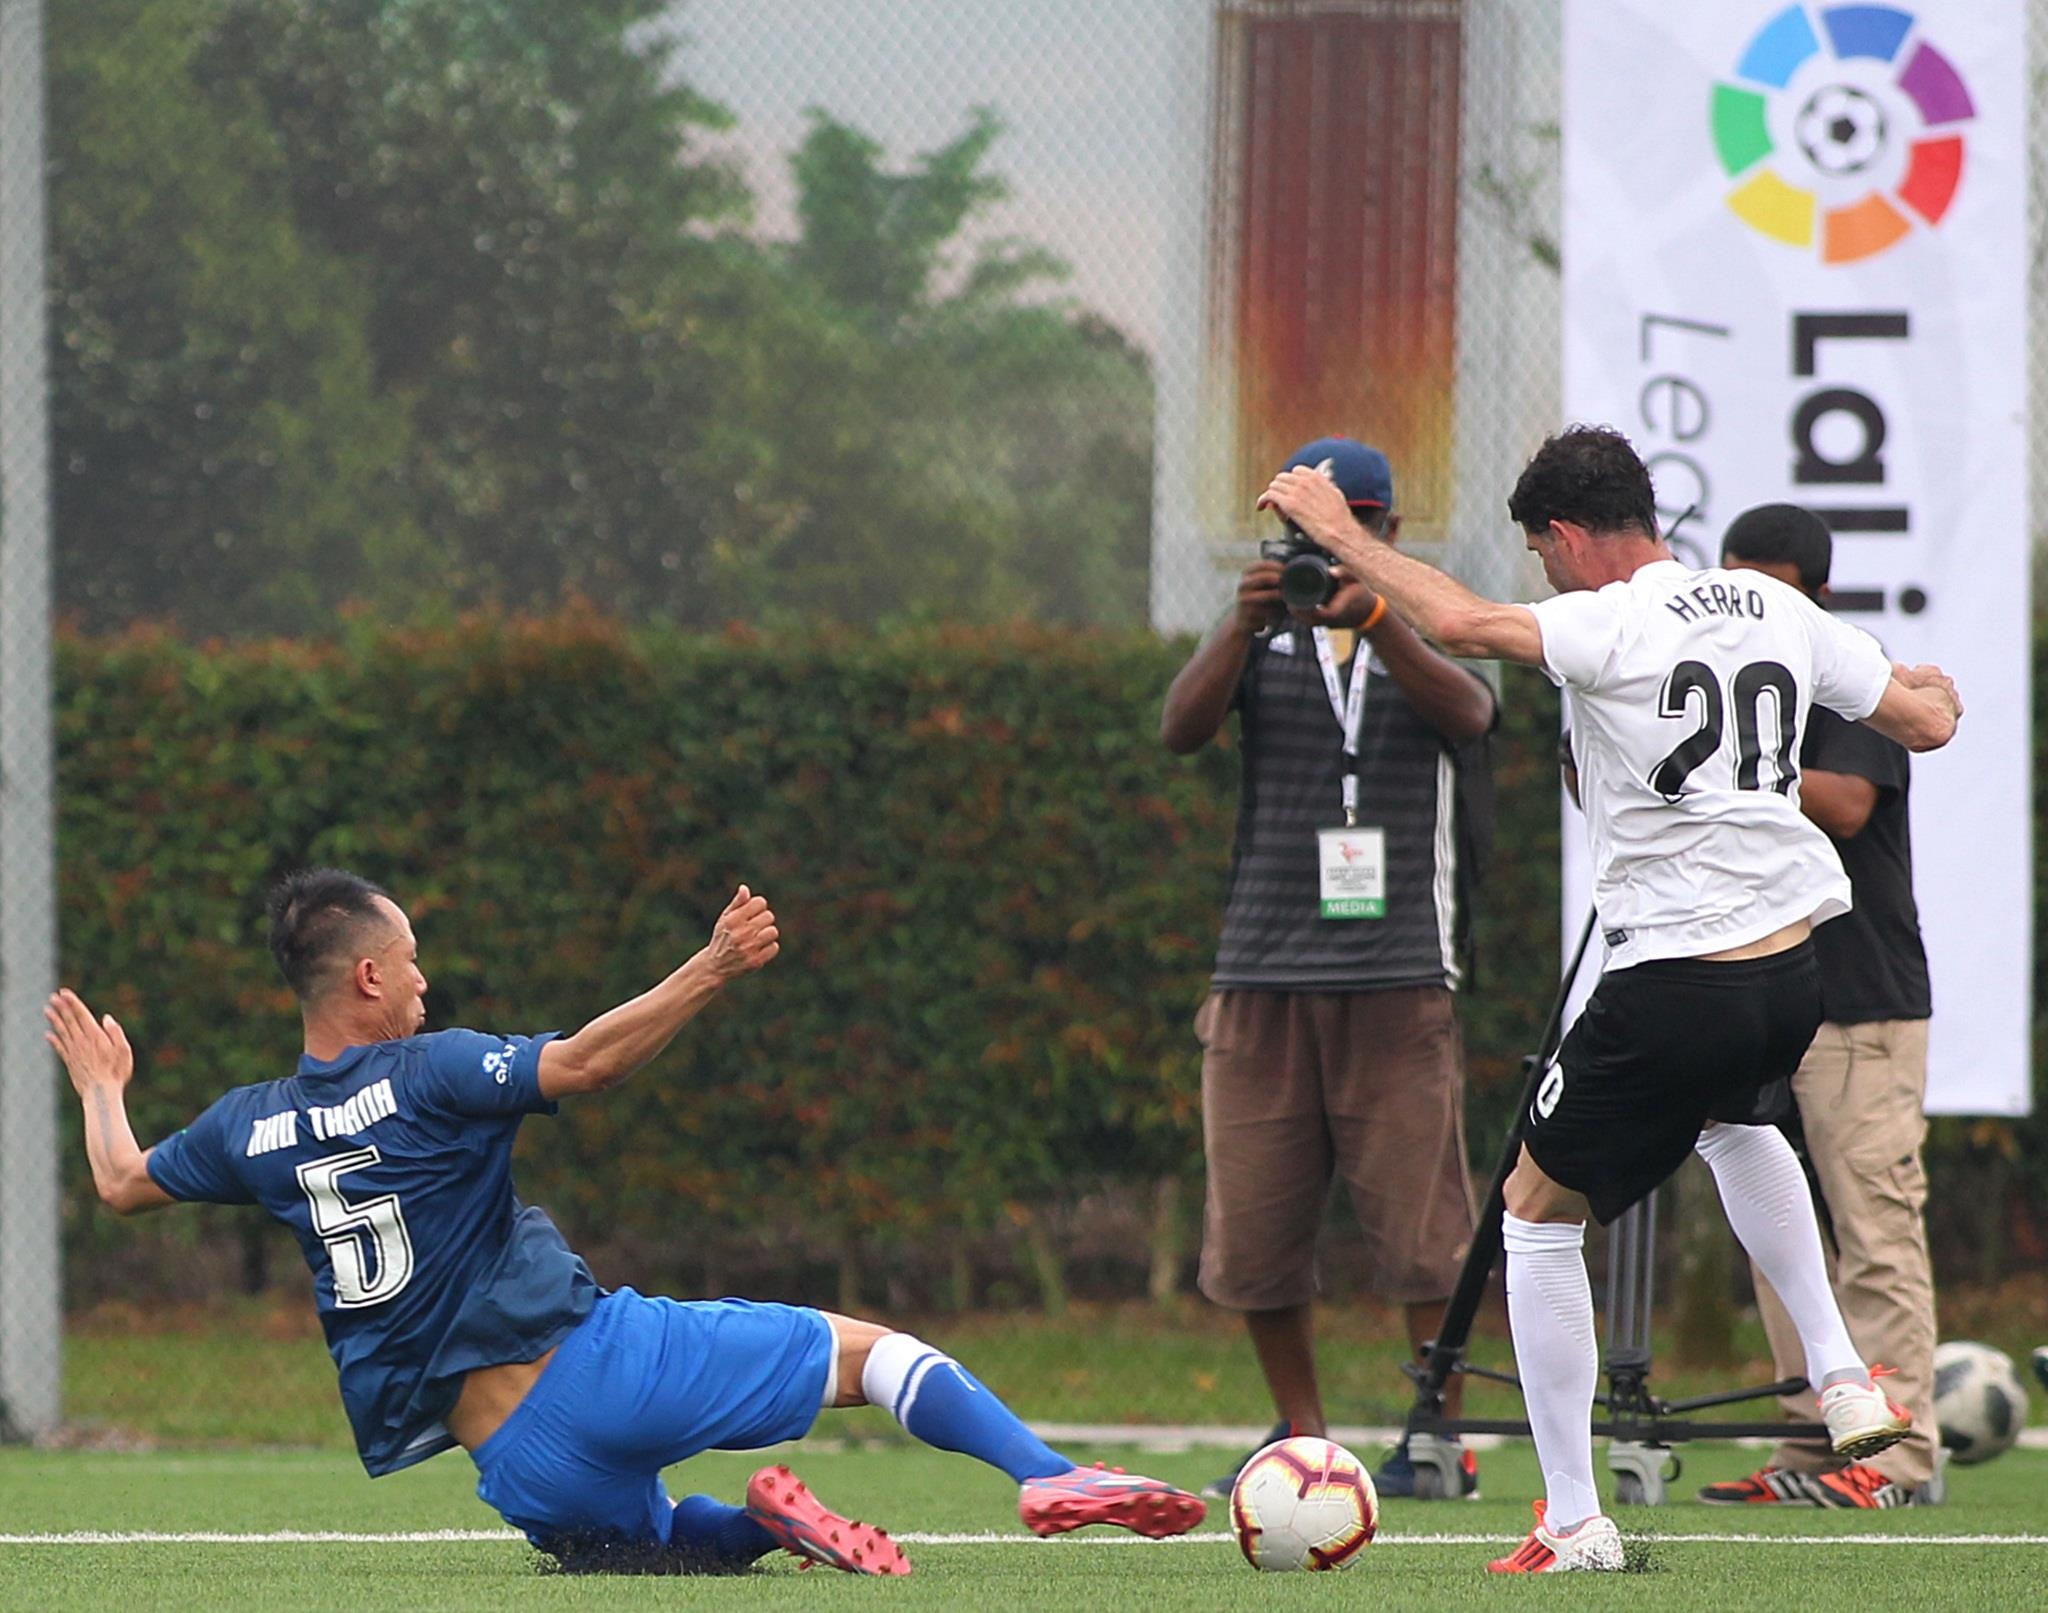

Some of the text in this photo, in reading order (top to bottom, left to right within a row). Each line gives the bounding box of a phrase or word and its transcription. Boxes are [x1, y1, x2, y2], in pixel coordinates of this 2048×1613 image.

[1664, 584, 1764, 624] HERRO
[1647, 660, 1798, 804] 20
[1326, 901, 1377, 914] MEDIA
[295, 1144, 414, 1309] 5
